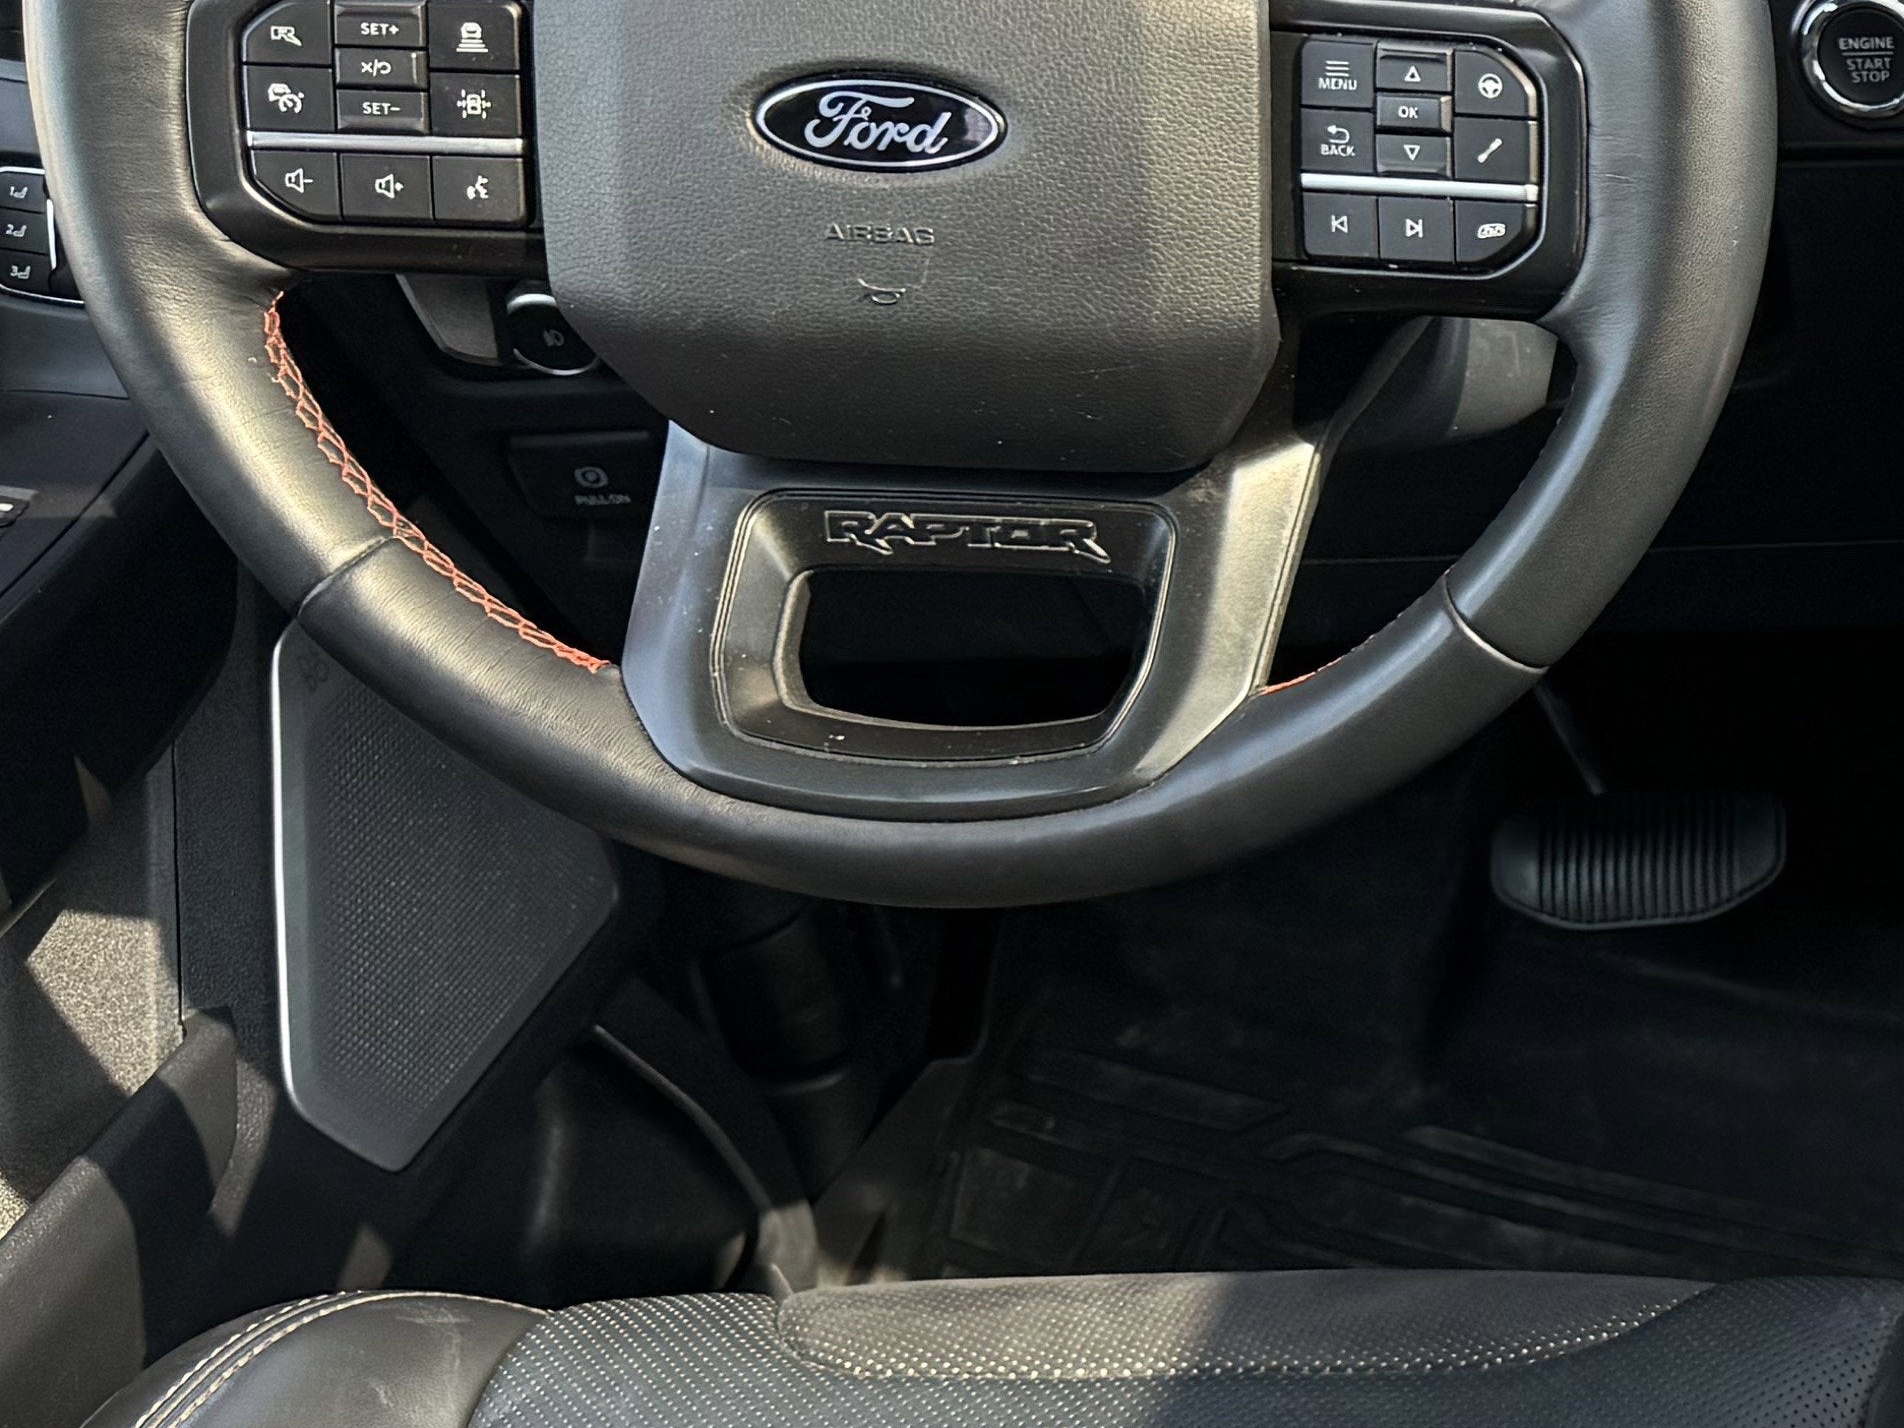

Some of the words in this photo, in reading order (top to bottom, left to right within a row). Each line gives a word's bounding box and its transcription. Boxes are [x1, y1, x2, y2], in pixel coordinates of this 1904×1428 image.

[1838, 36, 1895, 50] ENGINE
[1847, 58, 1892, 71] START
[1852, 71, 1890, 83] STOP
[1318, 78, 1357, 91] MENU
[1398, 106, 1418, 119] OK
[804, 90, 953, 154] Ford
[1320, 144, 1355, 157] BACK
[825, 222, 935, 246] AIRBAG
[823, 509, 1111, 564] RAPTOR
